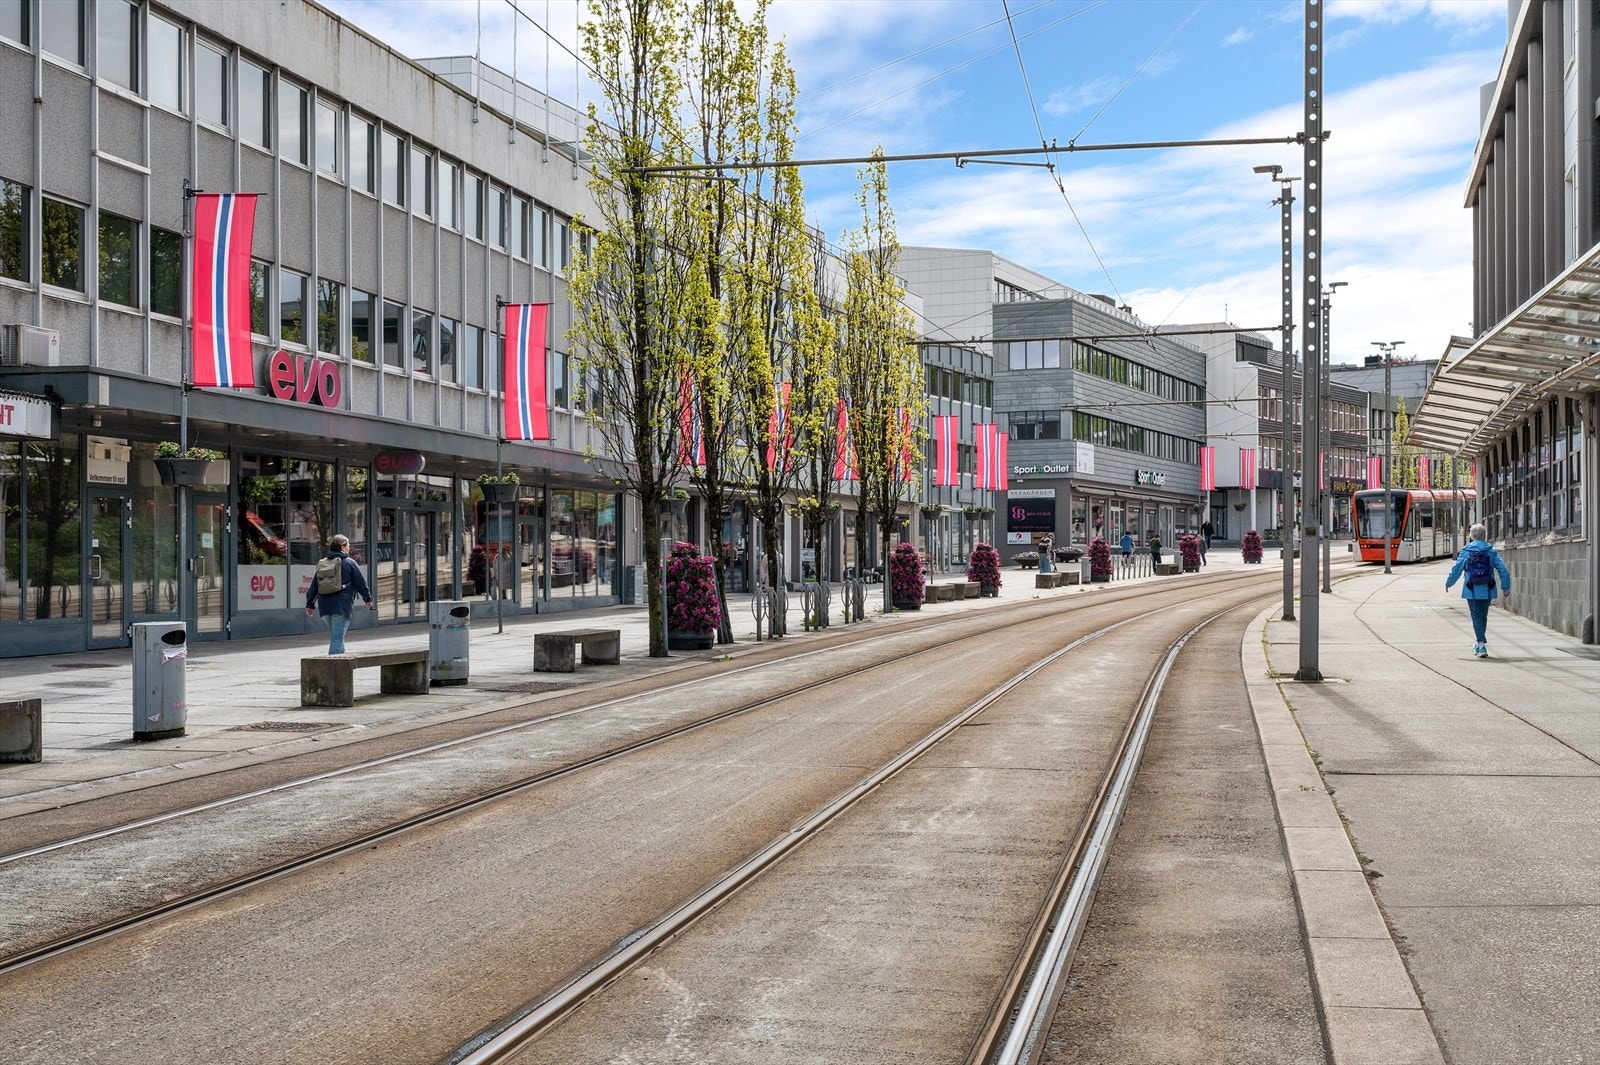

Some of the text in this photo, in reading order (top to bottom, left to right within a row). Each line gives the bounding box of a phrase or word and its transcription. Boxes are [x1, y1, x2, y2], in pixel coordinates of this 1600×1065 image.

[268, 350, 341, 408] evo
[377, 454, 418, 470] evo
[89, 473, 112, 482] Velkommen
[251, 575, 275, 592] evo
